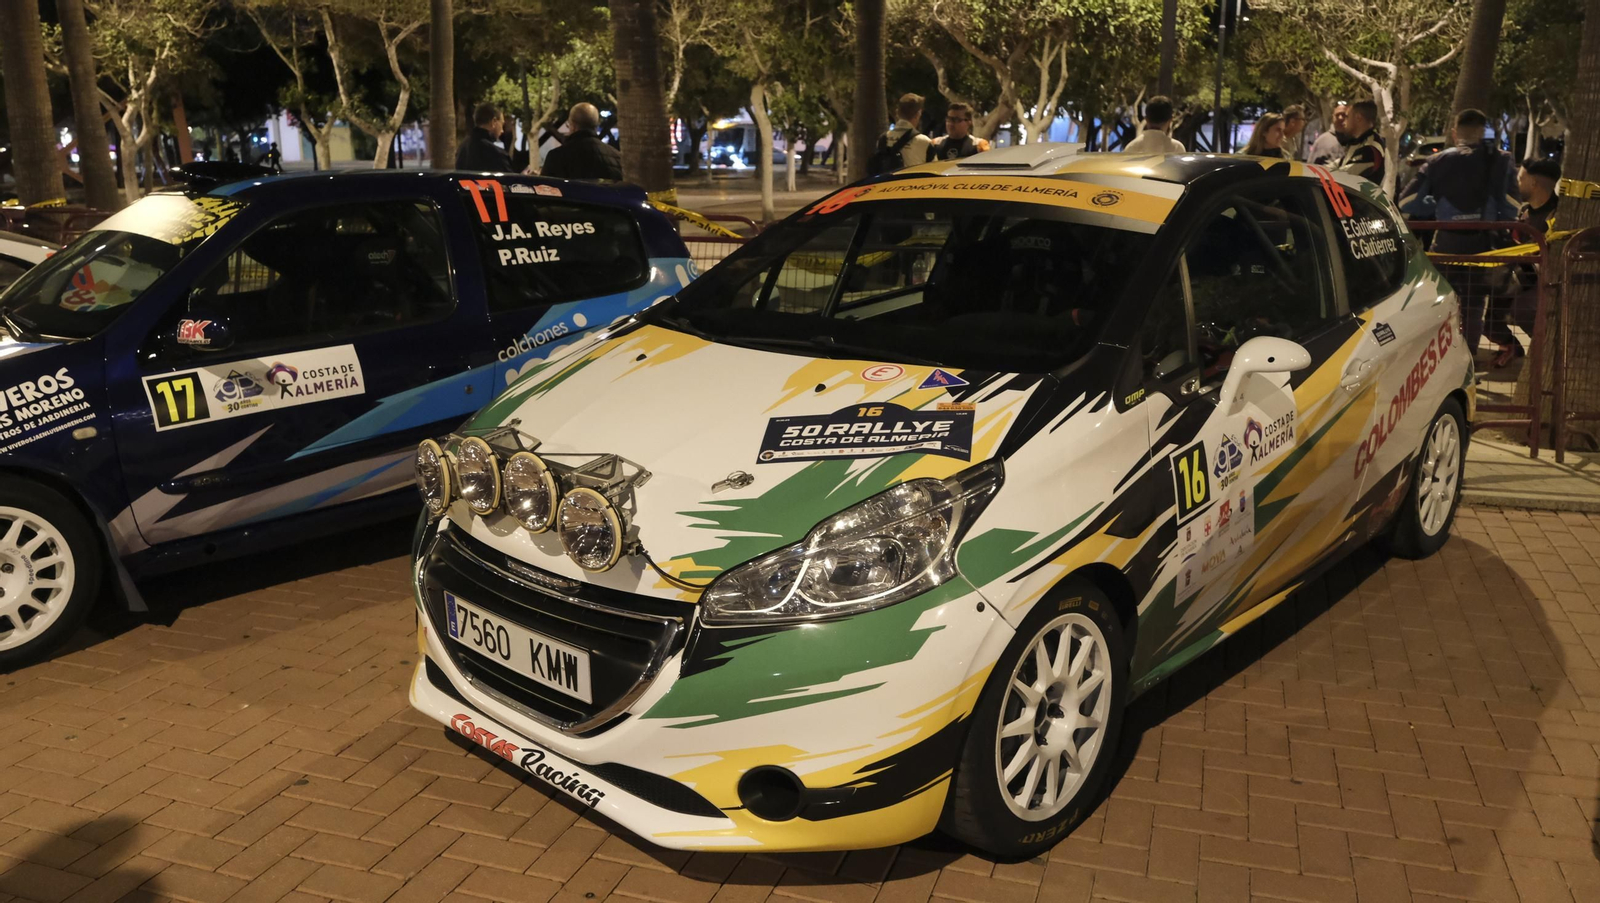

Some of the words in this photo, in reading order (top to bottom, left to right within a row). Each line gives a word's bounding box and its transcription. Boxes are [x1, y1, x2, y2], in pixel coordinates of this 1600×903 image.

[459, 180, 508, 222] 17
[878, 182, 950, 194] AUTOMÓVIL
[953, 183, 991, 191] CLUB
[990, 184, 1013, 192] DE
[1012, 185, 1079, 199] ALMERÍA
[1307, 165, 1353, 218] 16
[492, 223, 533, 241] J.A.
[535, 221, 596, 240] Reyes
[498, 246, 560, 266] P.Ruiz
[498, 322, 569, 362] colchones
[295, 374, 359, 397] ALMERÍA
[302, 367, 341, 380] COSTA
[341, 364, 355, 374] DE
[14, 388, 84, 422] MORENO
[156, 378, 195, 422] 17
[227, 402, 240, 413] 30
[1354, 312, 1453, 480] COLOMBES.ES
[23, 421, 37, 431] DE
[38, 401, 91, 426] JARDINERIA
[857, 406, 885, 417] 16
[1264, 419, 1286, 438] COSTA
[1286, 410, 1294, 425] DE
[779, 437, 838, 447] COSTA
[839, 436, 865, 444] DE
[782, 424, 823, 438] 50
[823, 420, 954, 436] RALLYE
[1258, 424, 1294, 461] ALMERÍA
[1178, 449, 1206, 510] 16
[1220, 476, 1229, 491] 30
[21, 554, 35, 586] speedline
[456, 604, 511, 661] 7560
[529, 638, 578, 692] KMW
[450, 713, 520, 762] COSTAS
[521, 747, 606, 808] Racing
